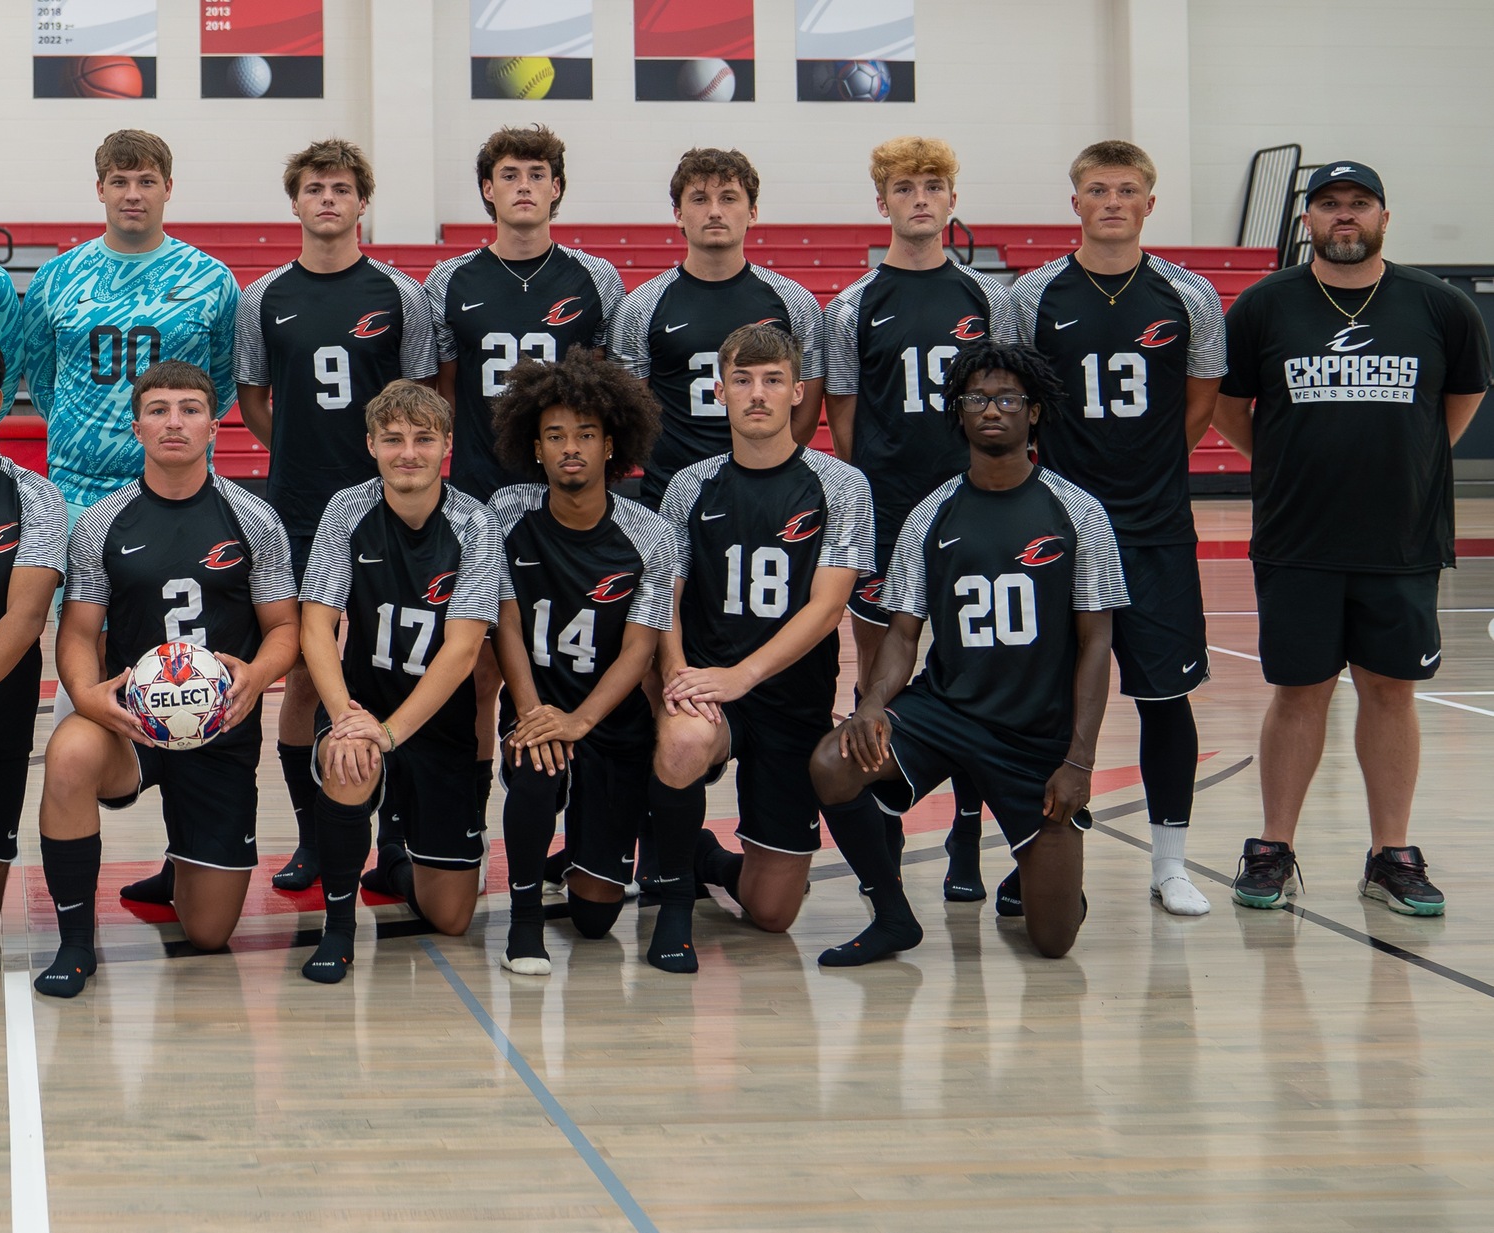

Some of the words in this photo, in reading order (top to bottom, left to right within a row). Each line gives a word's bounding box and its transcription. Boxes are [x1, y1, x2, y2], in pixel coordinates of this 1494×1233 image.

[37, 7, 61, 16] 2018
[38, 22, 61, 31] 2019
[38, 36, 61, 45] 2022
[205, 6, 231, 17] 2013
[205, 20, 232, 31] 2014
[89, 325, 161, 385] 00
[313, 345, 352, 410] 9
[689, 351, 727, 417] 2
[900, 345, 960, 413] 19
[1081, 352, 1148, 419] 13
[1284, 355, 1419, 389] EXPRESS
[1294, 390, 1337, 400] MEN'S
[1346, 389, 1410, 400] SOCCER
[162, 577, 207, 647] 2
[723, 544, 790, 618] 18
[954, 572, 1038, 648] 20
[372, 602, 436, 676] 17
[532, 598, 597, 673] 14
[150, 687, 210, 709] SELECT
